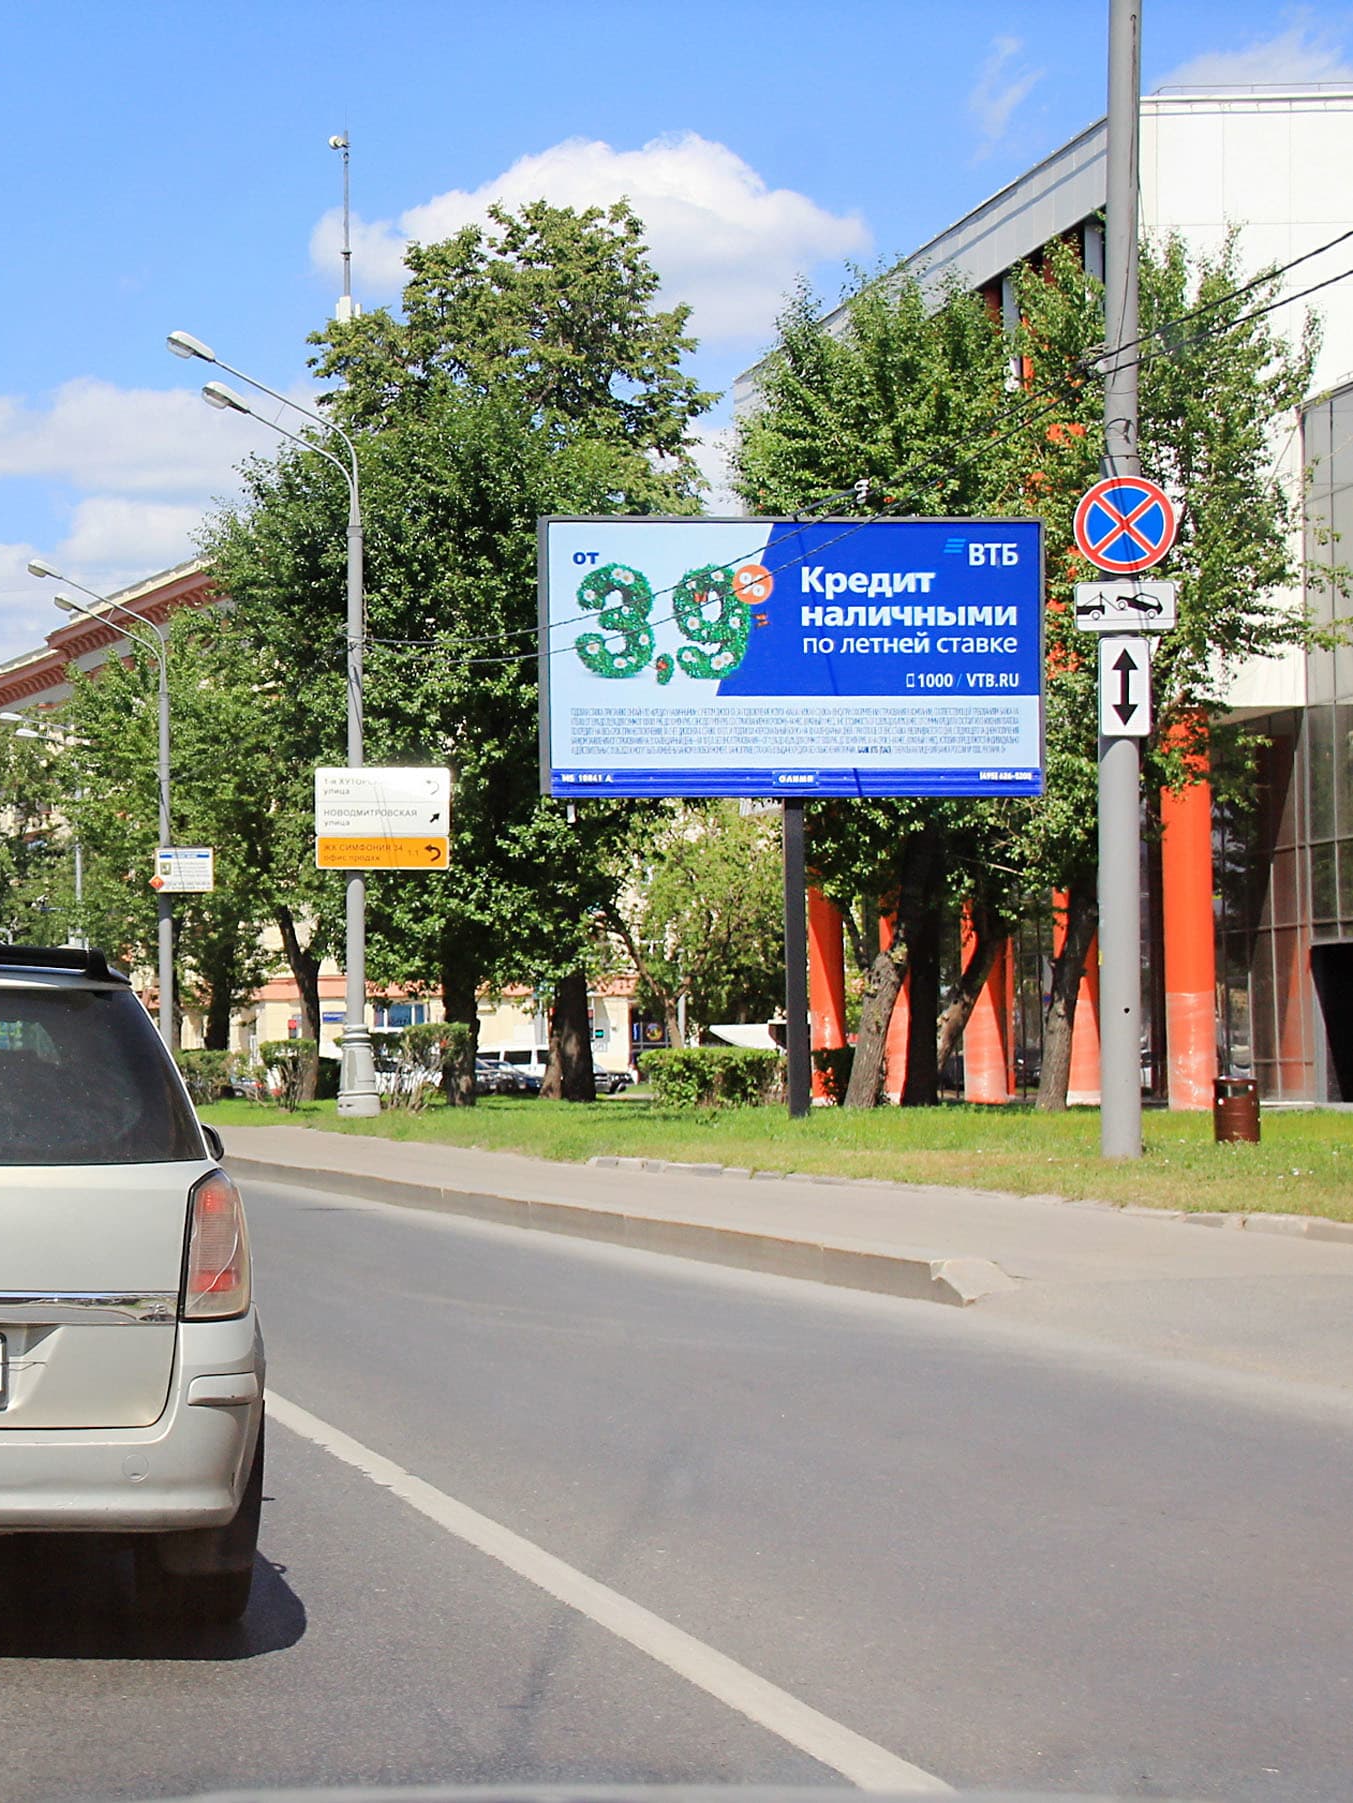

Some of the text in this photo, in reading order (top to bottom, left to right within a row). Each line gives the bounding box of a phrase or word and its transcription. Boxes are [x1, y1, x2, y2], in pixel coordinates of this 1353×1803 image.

[968, 543, 1019, 566] ВТБ
[801, 566, 936, 600] Кредит
[801, 605, 1017, 627] наличными
[803, 631, 1018, 654] по летней ставке
[918, 673, 953, 688] 1000
[966, 673, 1019, 688] VTB.RU
[324, 809, 417, 817] НОВОДМИТРОВСКАЯ
